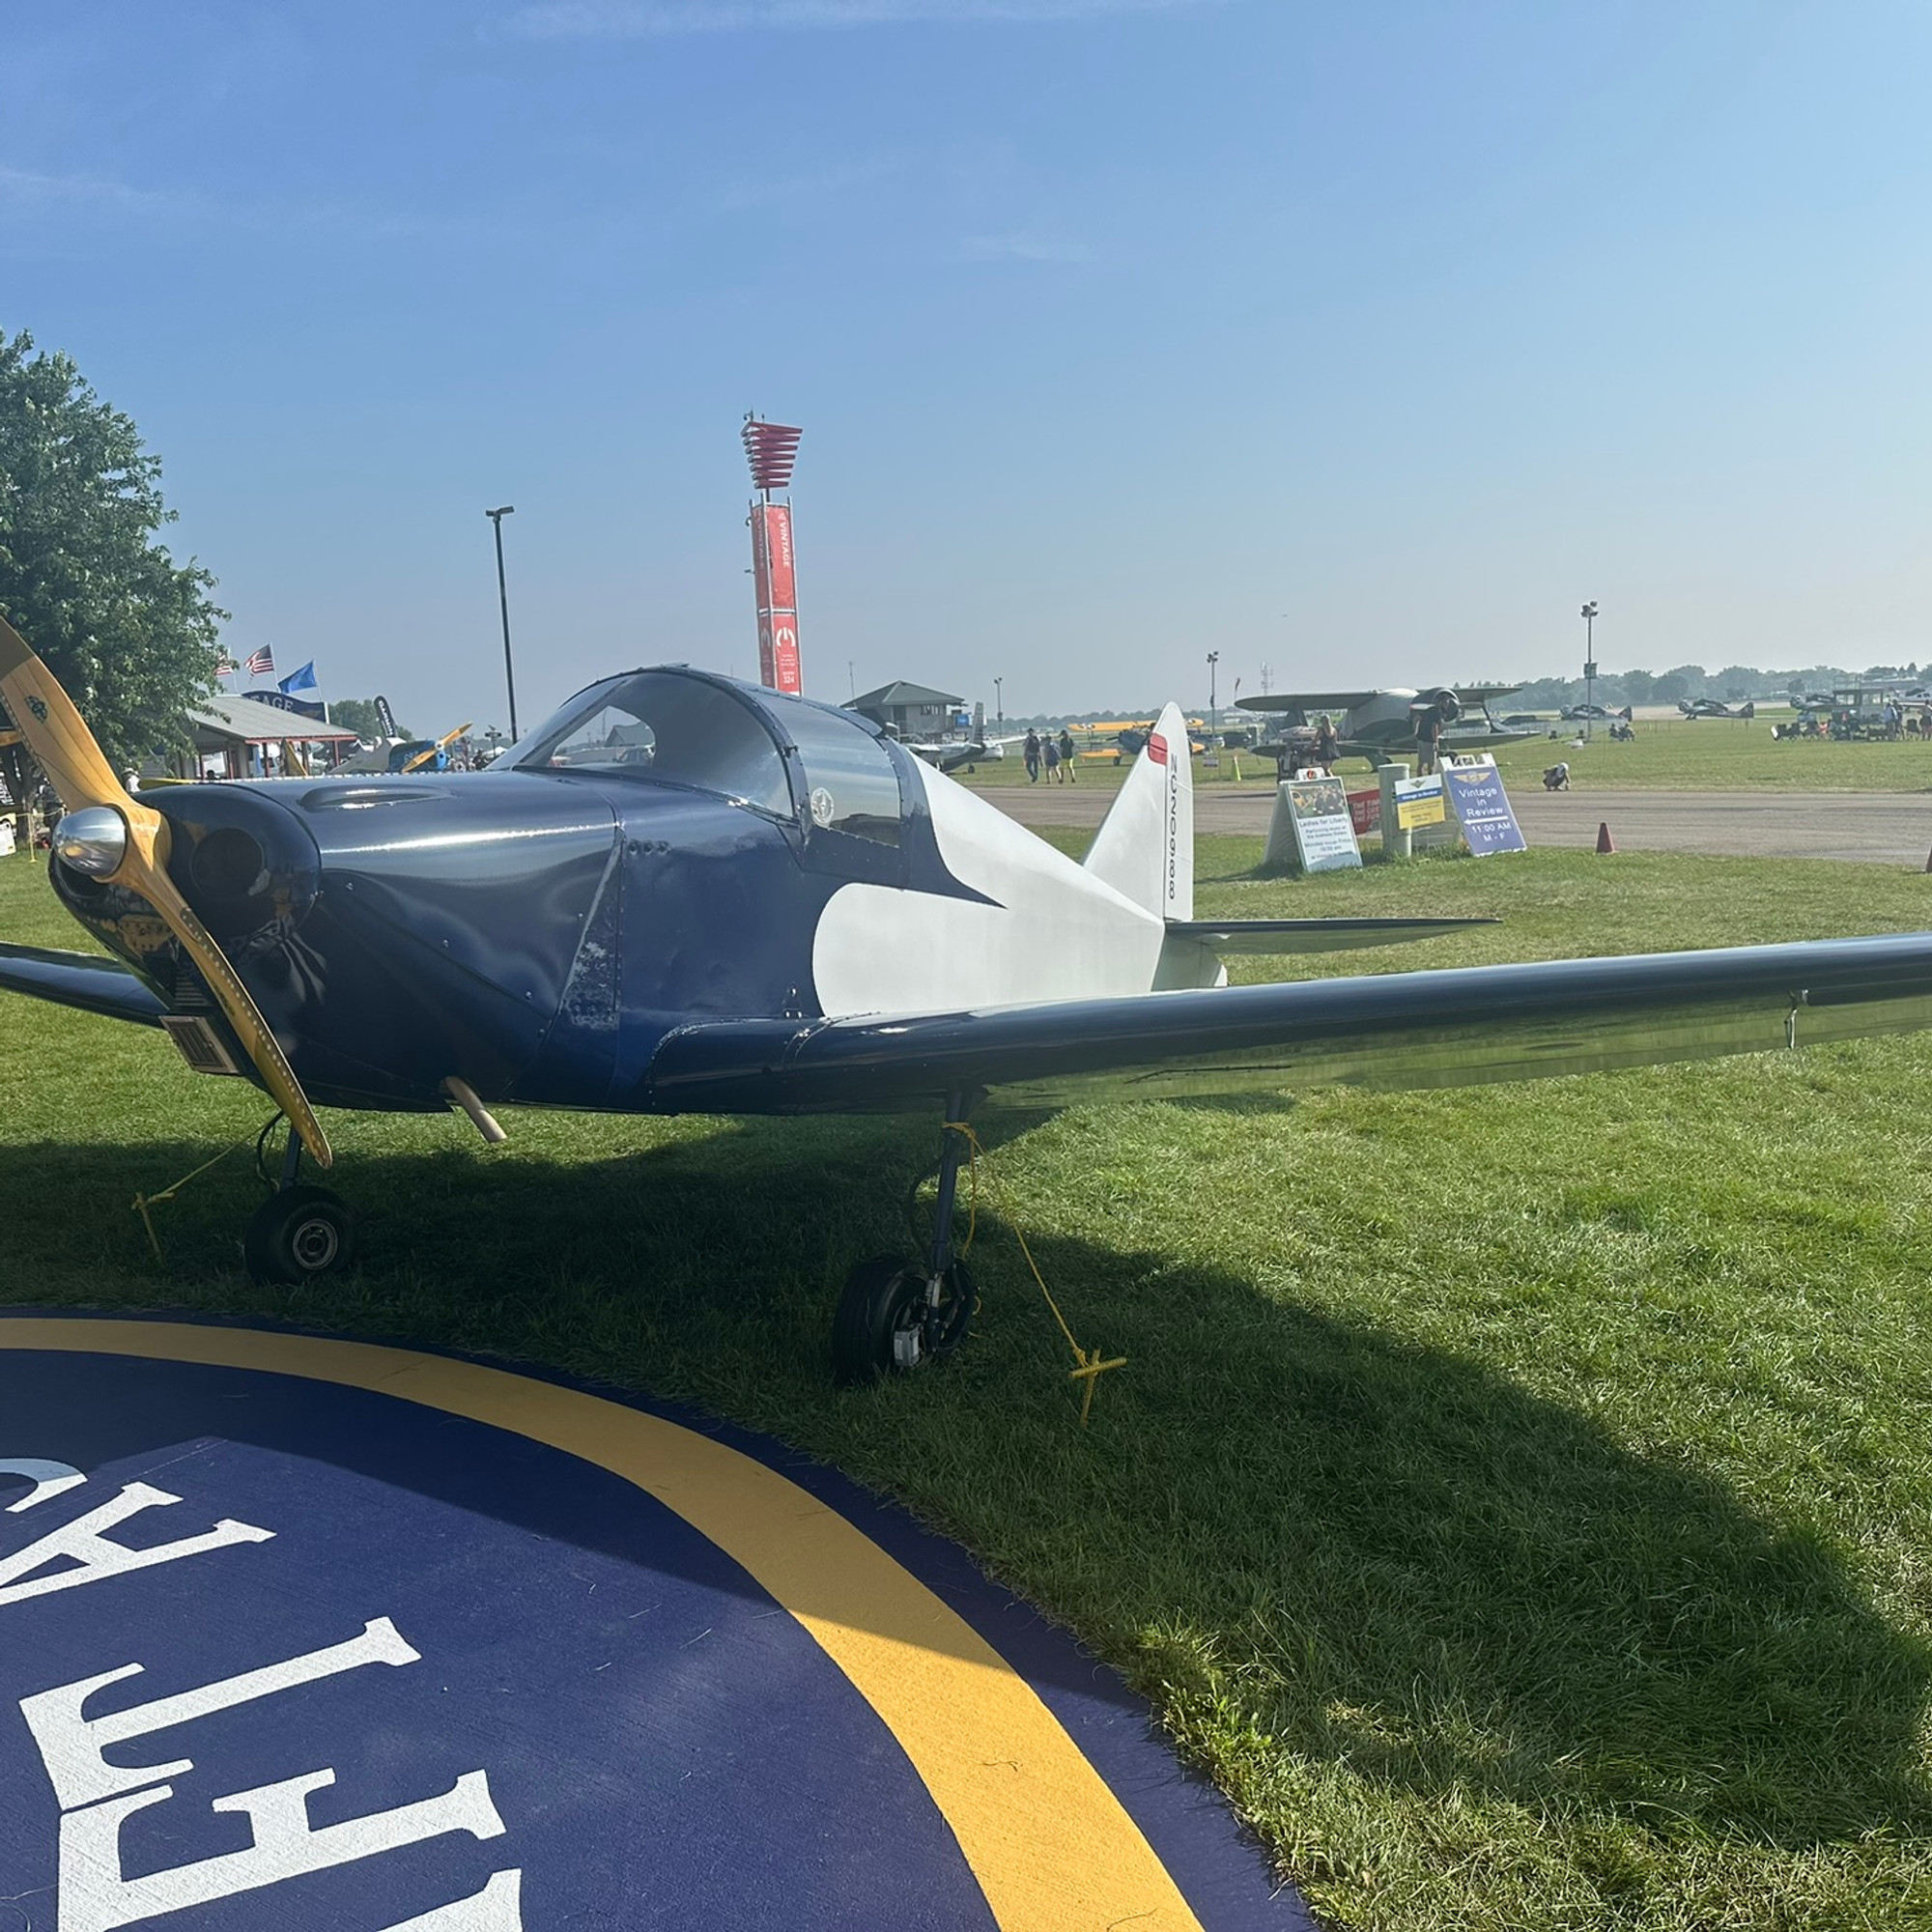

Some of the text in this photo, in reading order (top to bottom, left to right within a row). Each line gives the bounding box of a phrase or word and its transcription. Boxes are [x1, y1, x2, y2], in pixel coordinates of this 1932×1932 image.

[780, 522, 790, 567] VINTAGE
[1458, 787, 1498, 798] Vintage
[1466, 807, 1503, 817] Review
[1169, 753, 1178, 899] NC20988
[1472, 824, 1495, 833] 11:00
